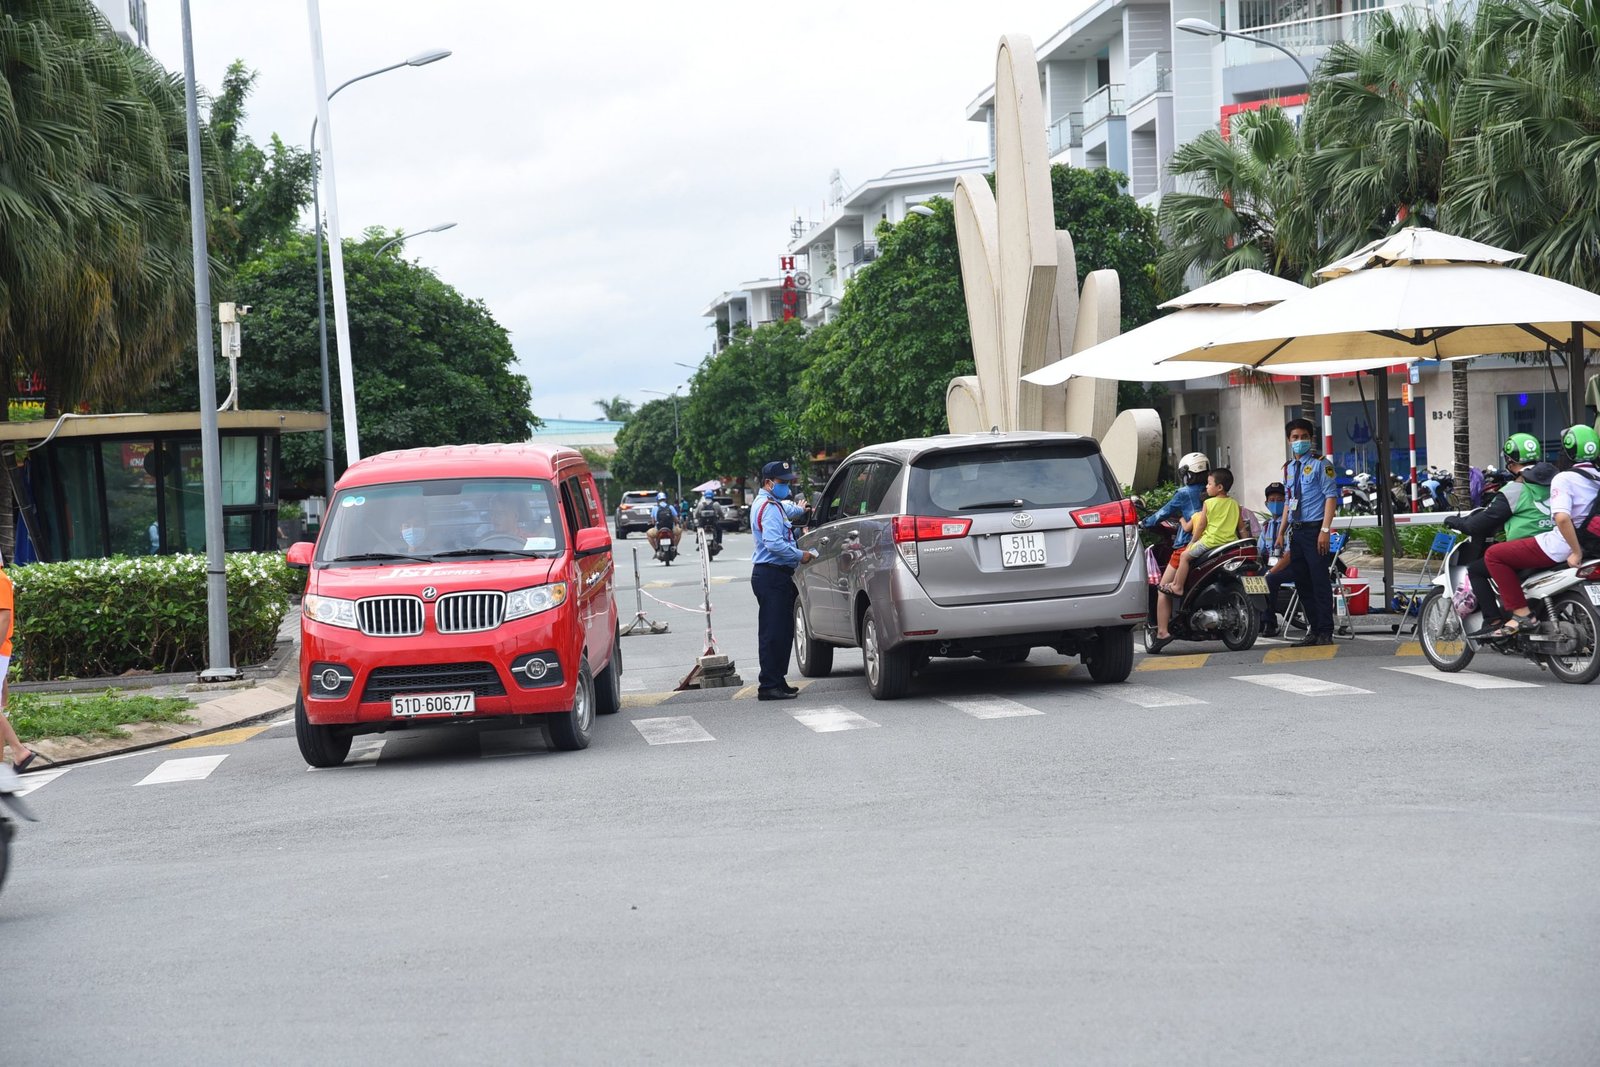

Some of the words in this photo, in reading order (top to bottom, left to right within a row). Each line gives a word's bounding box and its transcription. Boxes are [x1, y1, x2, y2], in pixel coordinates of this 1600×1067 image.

[1432, 410, 1454, 420] B3-0
[1012, 535, 1035, 550] 51H
[1005, 548, 1045, 565] 278.03
[395, 694, 471, 714] 51D-606.77
